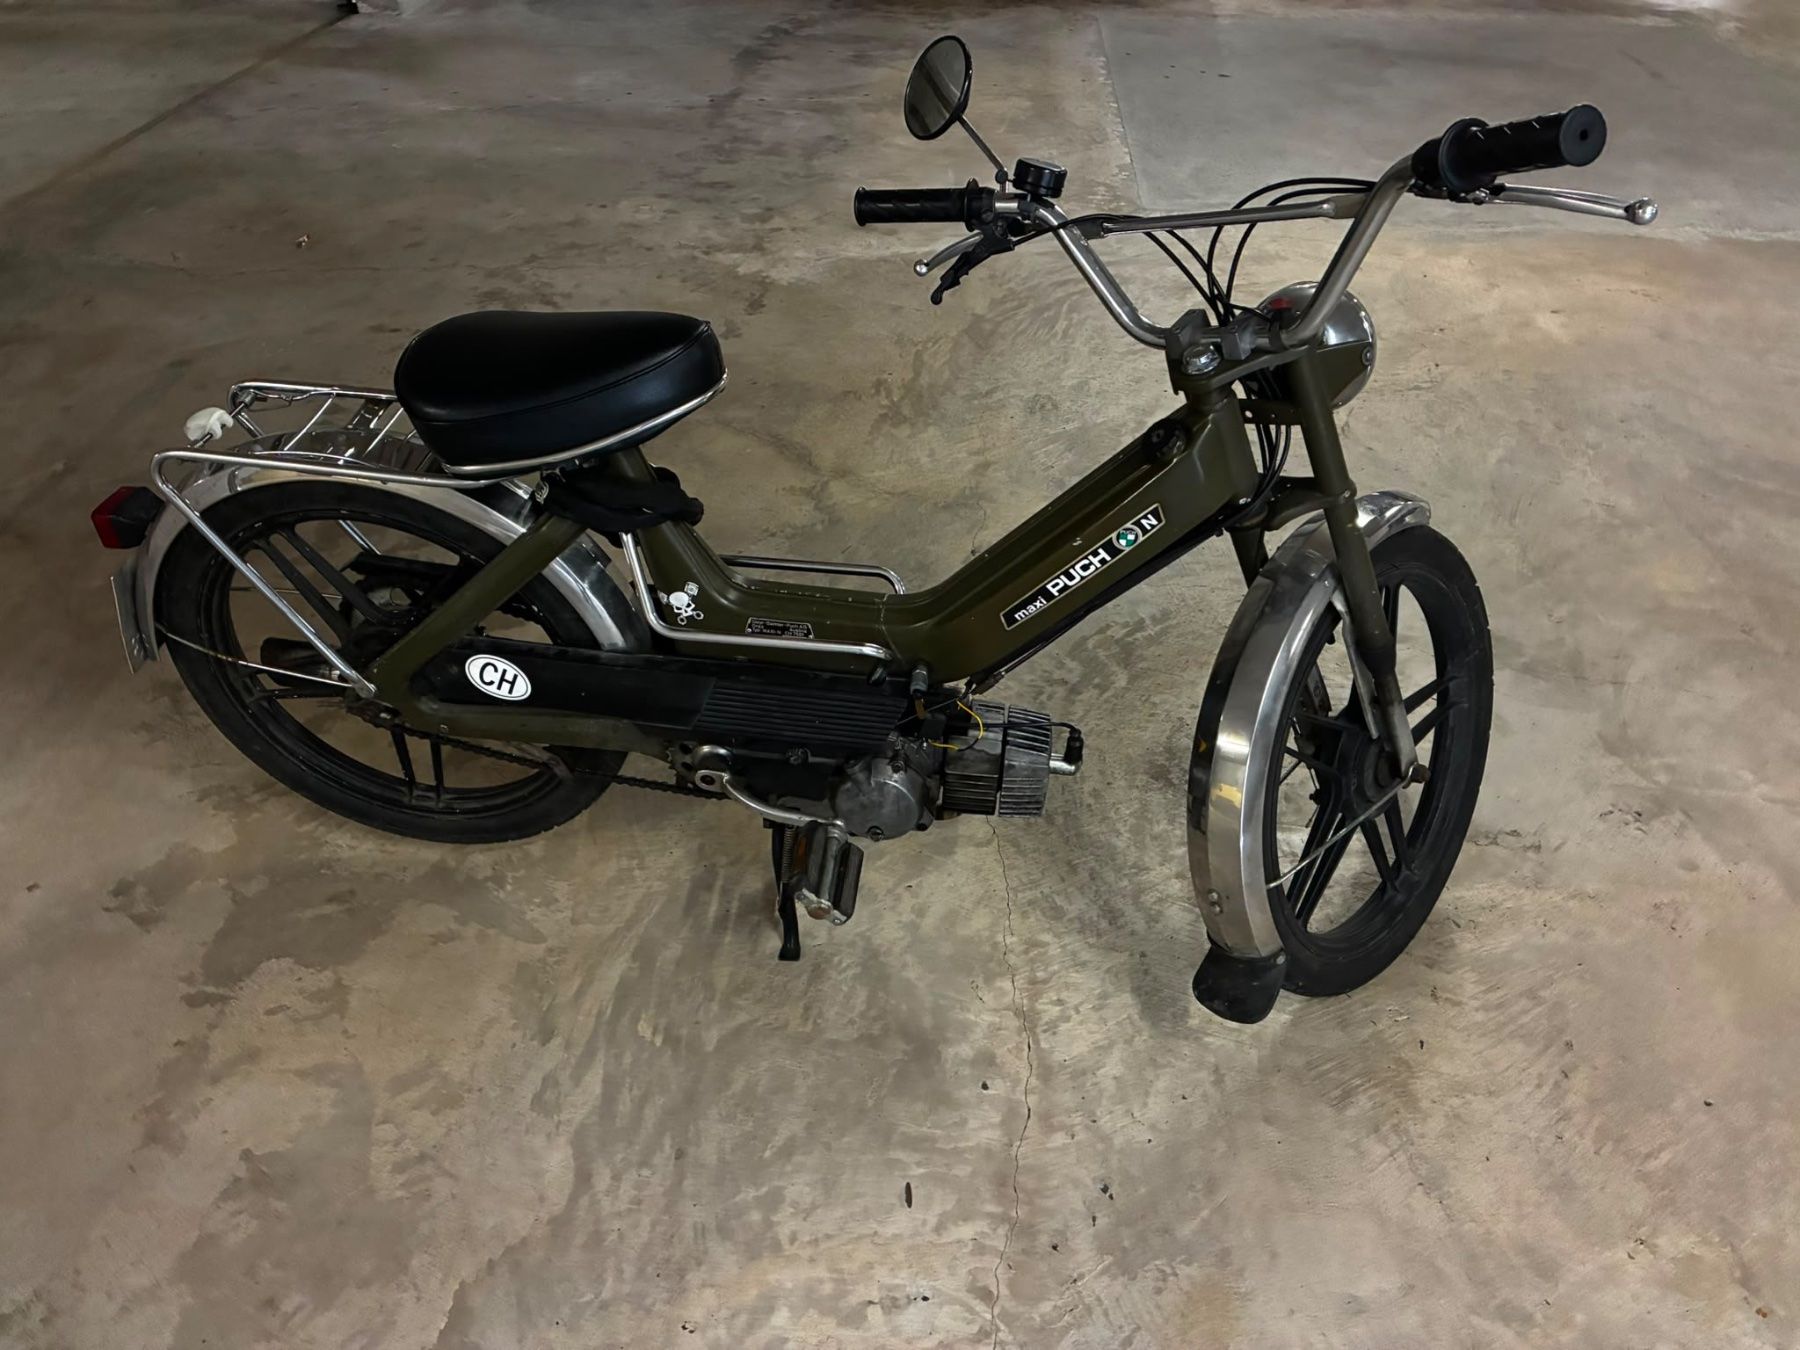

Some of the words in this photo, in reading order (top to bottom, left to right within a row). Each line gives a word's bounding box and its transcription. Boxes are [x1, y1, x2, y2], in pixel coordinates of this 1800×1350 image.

[1014, 596, 1047, 621] maxi
[1046, 548, 1111, 596] PUCH
[1140, 514, 1159, 530] N
[479, 662, 518, 695] CH
